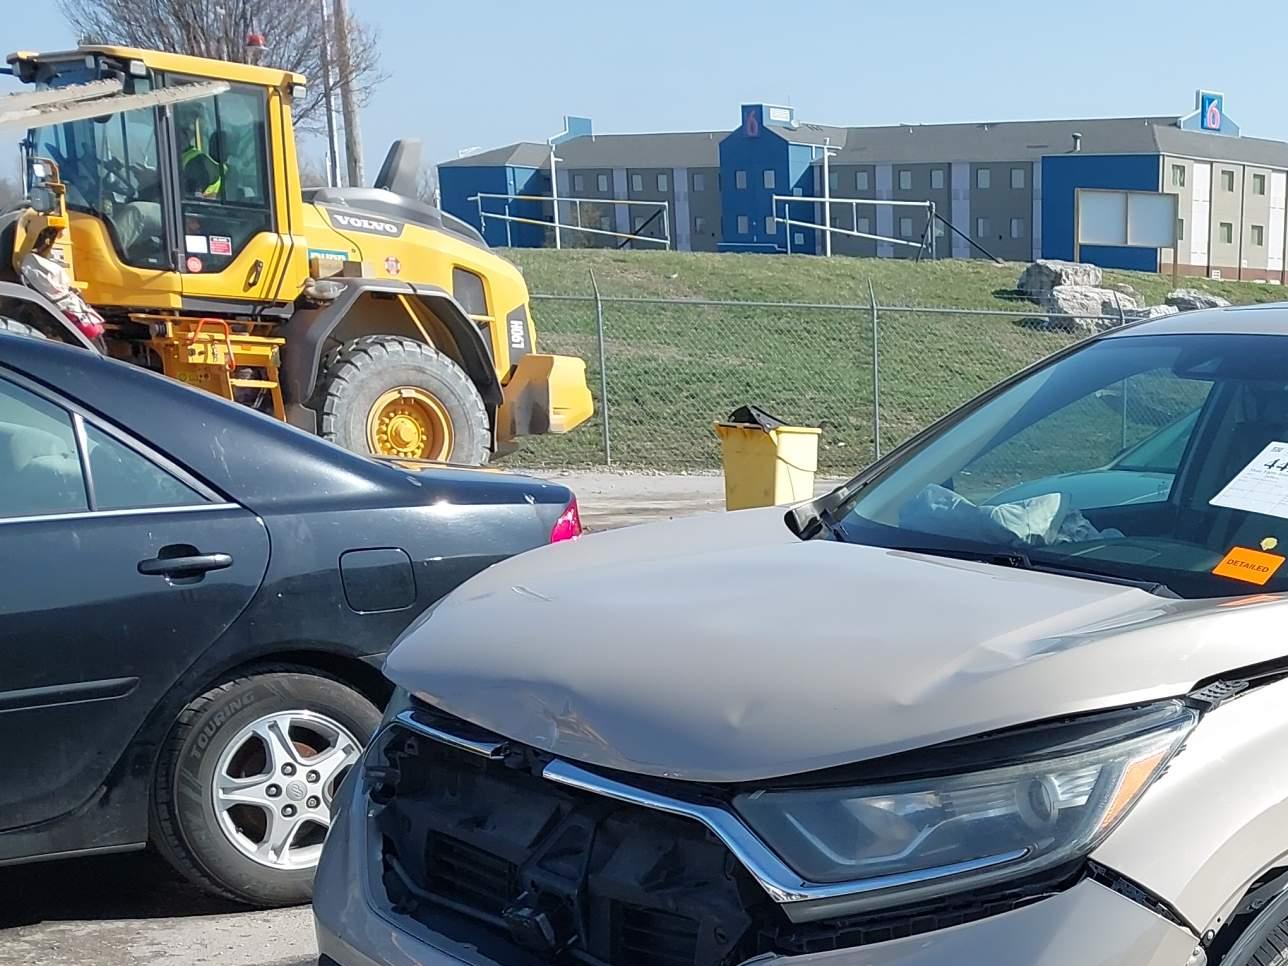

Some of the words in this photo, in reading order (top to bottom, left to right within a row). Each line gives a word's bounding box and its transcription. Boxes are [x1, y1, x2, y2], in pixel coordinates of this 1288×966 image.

[746, 108, 759, 137] 6
[1207, 99, 1221, 129] 6
[334, 214, 398, 233] VOLVO
[510, 320, 525, 349] L90H
[1226, 558, 1271, 575] DETAILED
[190, 690, 256, 760] TOURING
